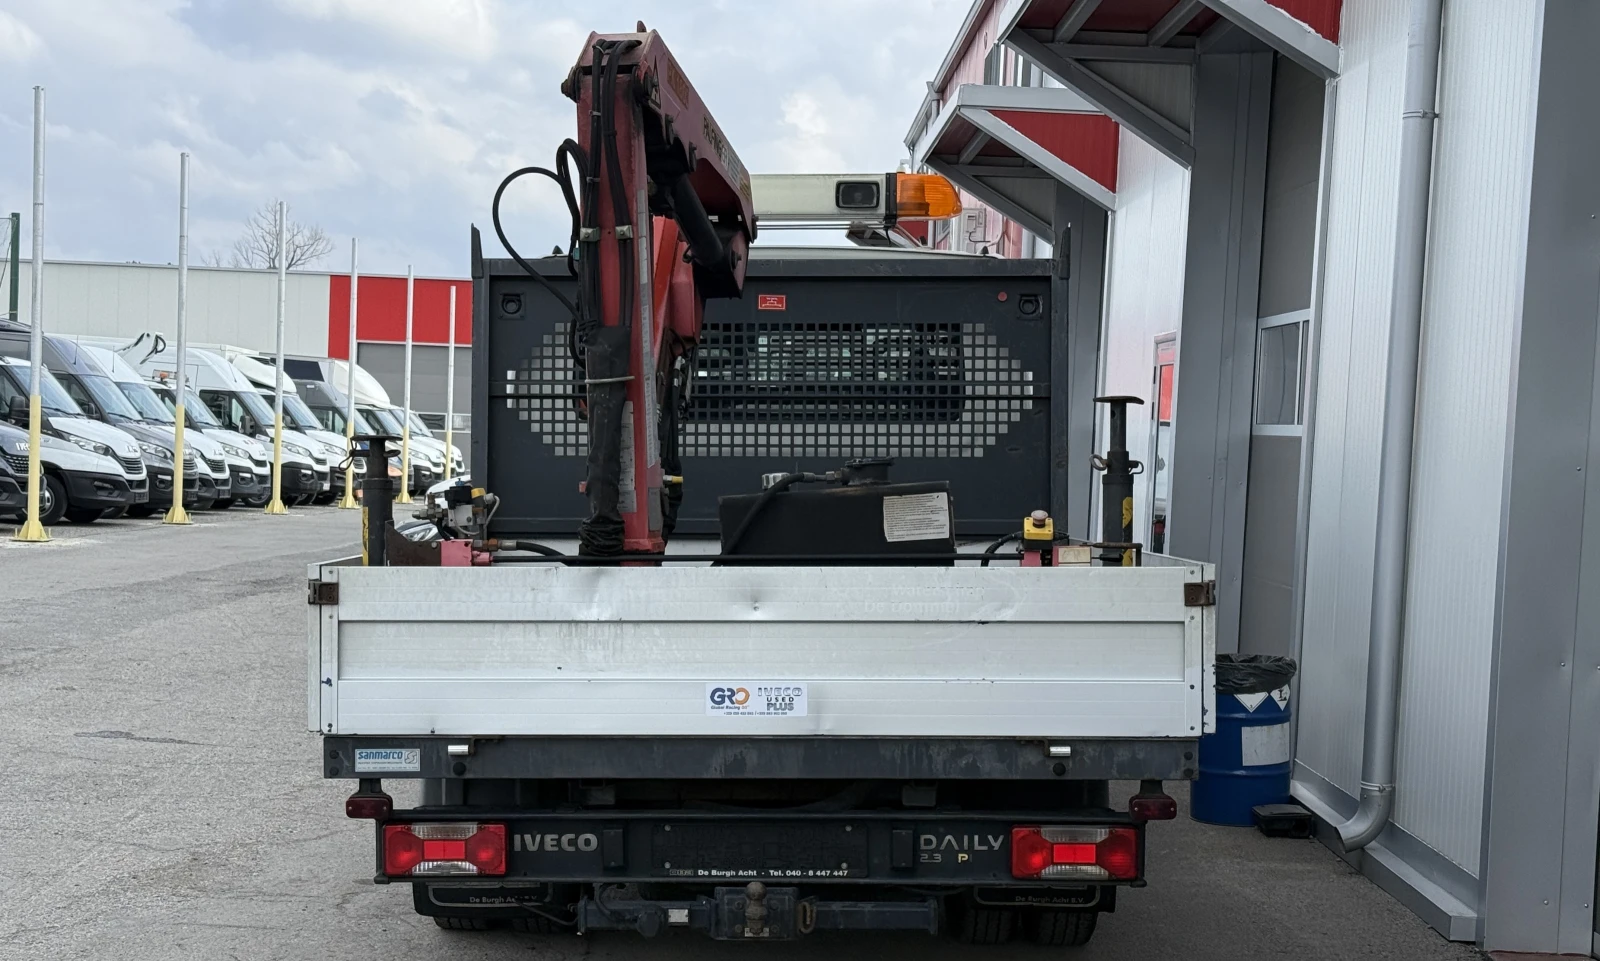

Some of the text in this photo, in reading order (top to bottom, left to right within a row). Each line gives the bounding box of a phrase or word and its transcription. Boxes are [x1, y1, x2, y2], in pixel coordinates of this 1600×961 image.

[709, 687, 750, 706] GRO
[757, 687, 803, 697] IVECO
[766, 702, 795, 711] PLUS
[357, 750, 403, 760] sanmarco
[513, 833, 598, 852] IVECO
[919, 834, 1005, 851] DAILY
[711, 869, 736, 877] Burgh
[482, 895, 505, 904] Burgh
